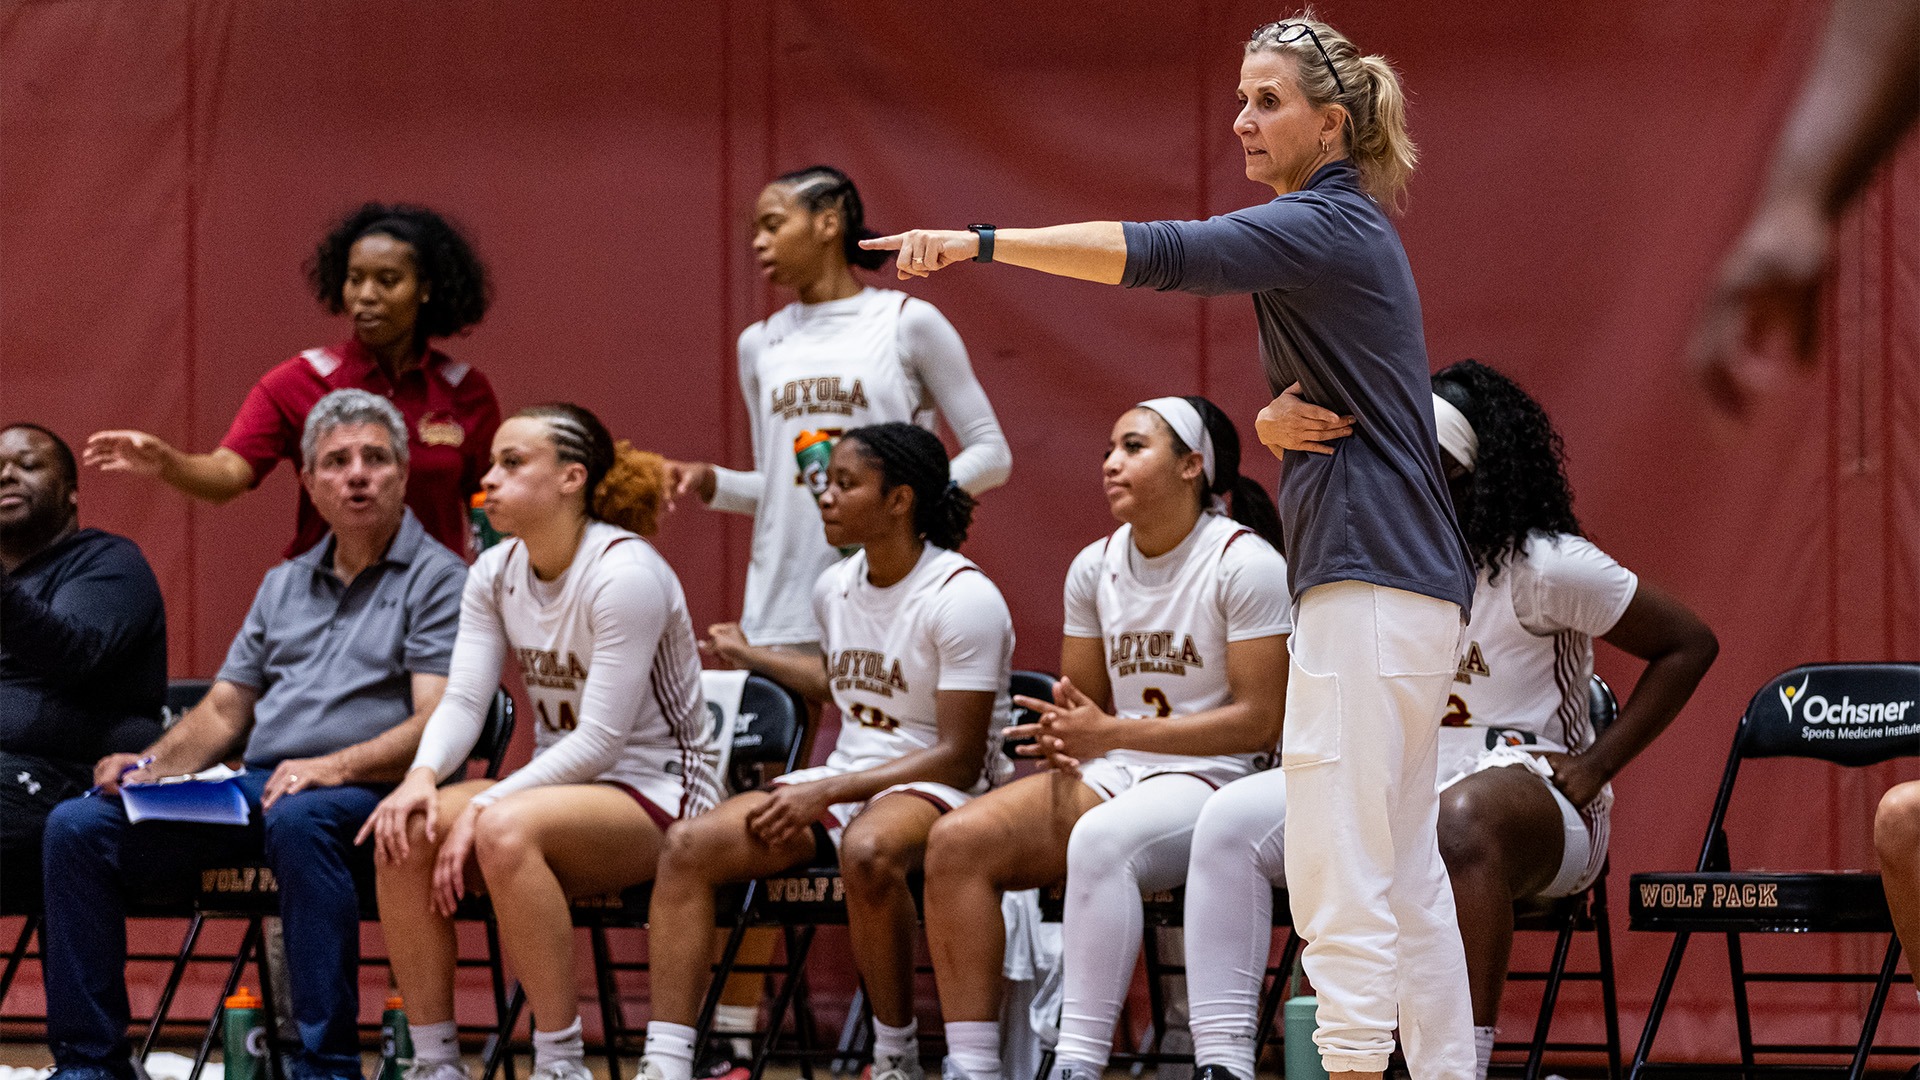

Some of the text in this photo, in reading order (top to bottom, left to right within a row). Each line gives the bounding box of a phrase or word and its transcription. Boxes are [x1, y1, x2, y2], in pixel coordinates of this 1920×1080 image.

[771, 377, 868, 415] LOYOLA
[1110, 629, 1203, 668] LOYOLA
[829, 649, 909, 693] LOYOLA
[1803, 695, 1911, 724] Ochsner
[1802, 723, 1920, 741] Sports Medicine Institute
[766, 878, 829, 902] WOLF
[1640, 884, 1778, 907] WOLF PACK
